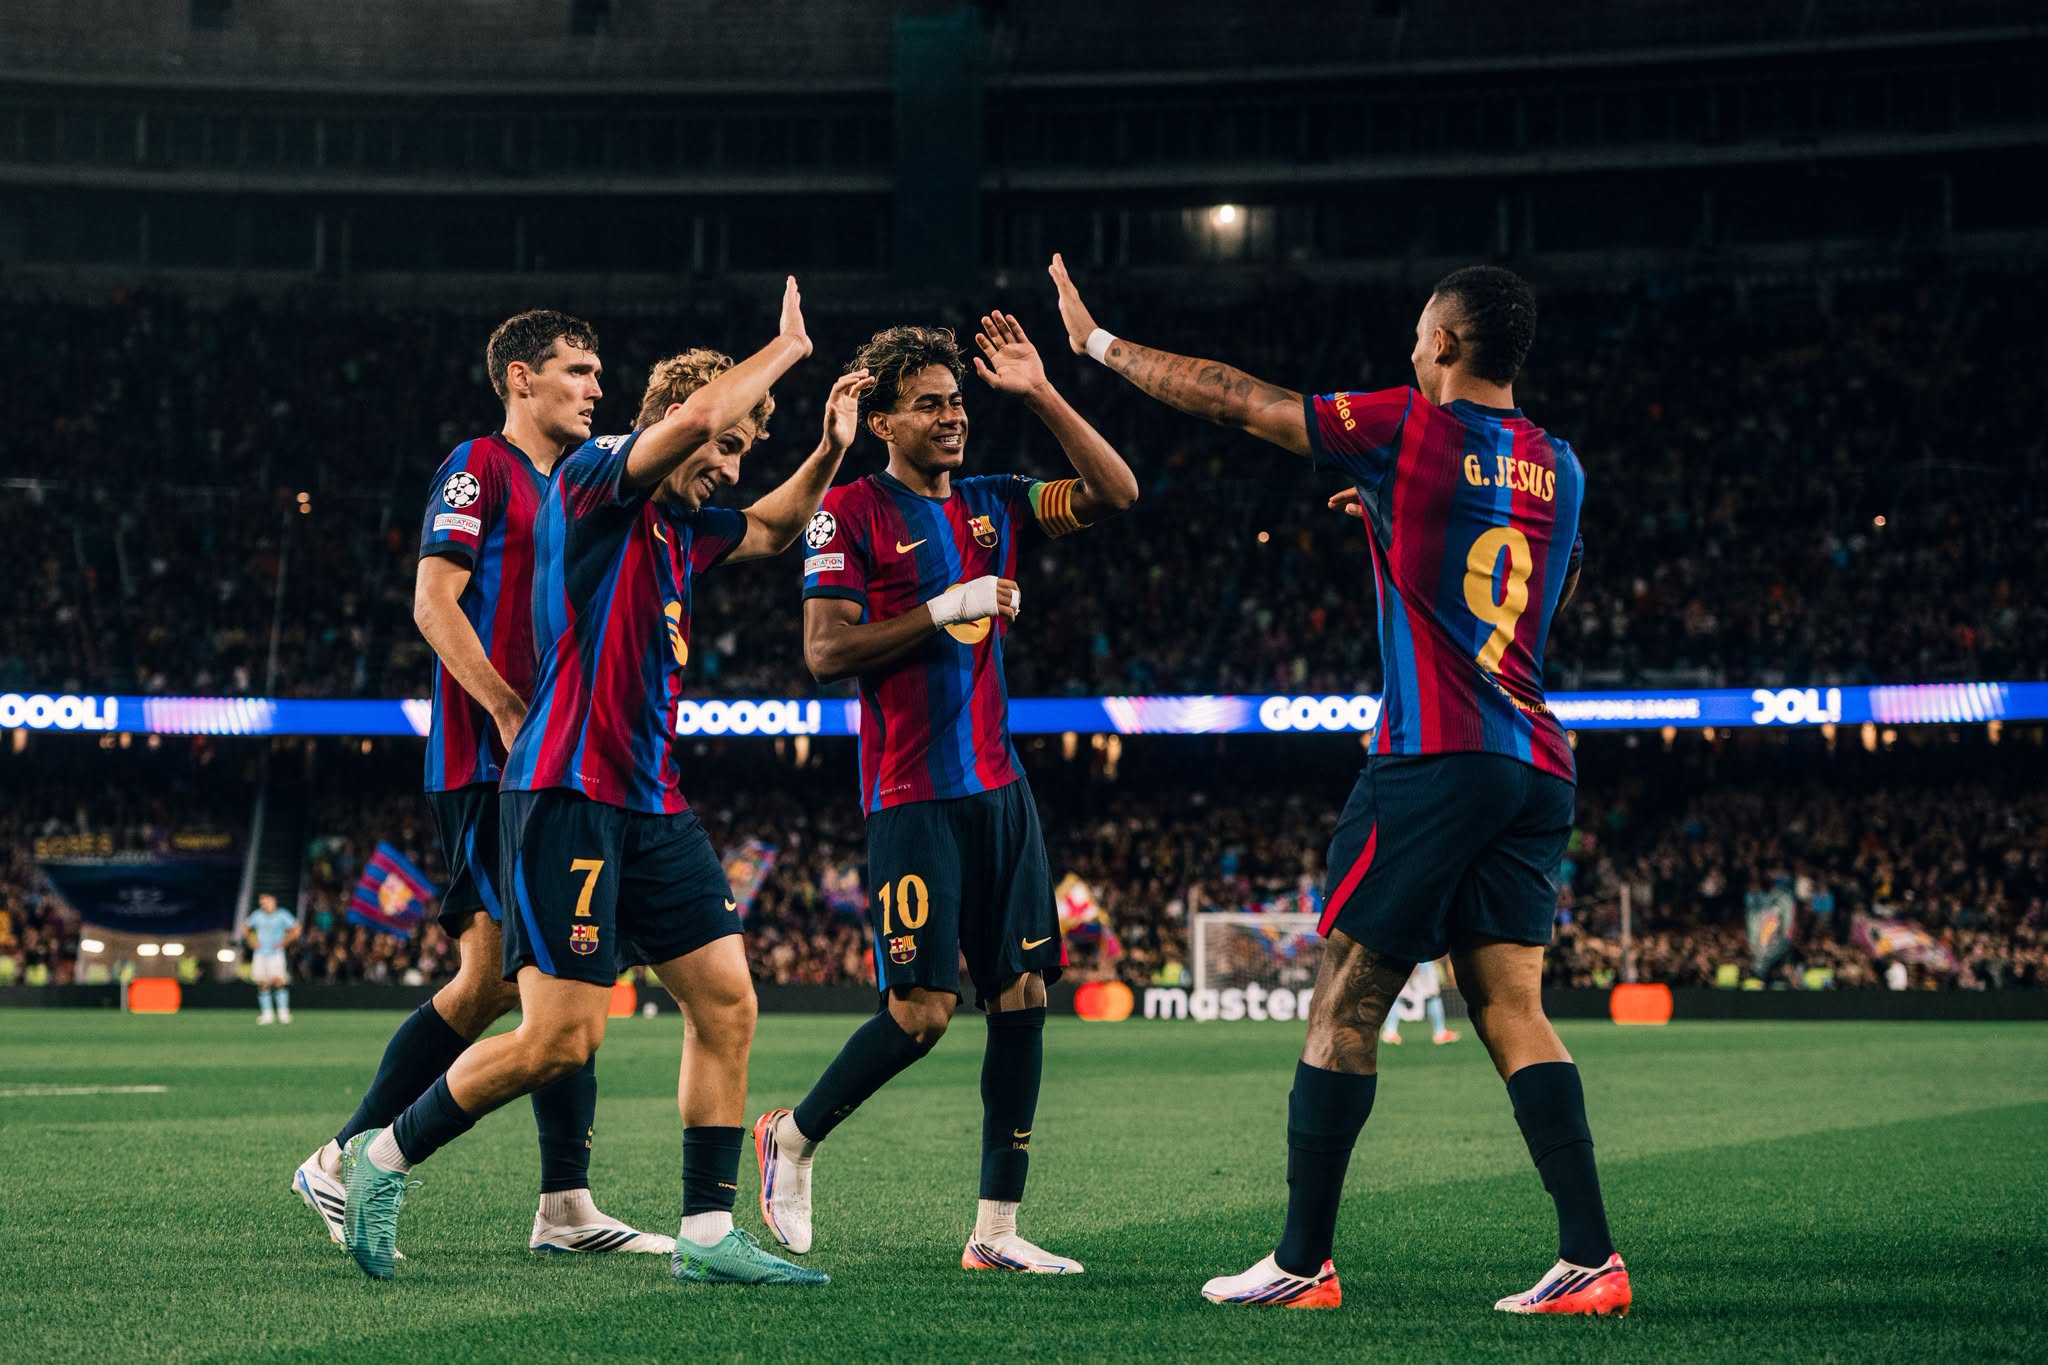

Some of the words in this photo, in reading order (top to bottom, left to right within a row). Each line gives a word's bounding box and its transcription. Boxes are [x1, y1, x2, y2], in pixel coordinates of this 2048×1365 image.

[1495, 455, 1555, 502] JESUS
[1463, 527, 1533, 674] 9
[1259, 695, 1382, 731] GOOO
[569, 858, 605, 917] 7
[878, 874, 929, 936] 10
